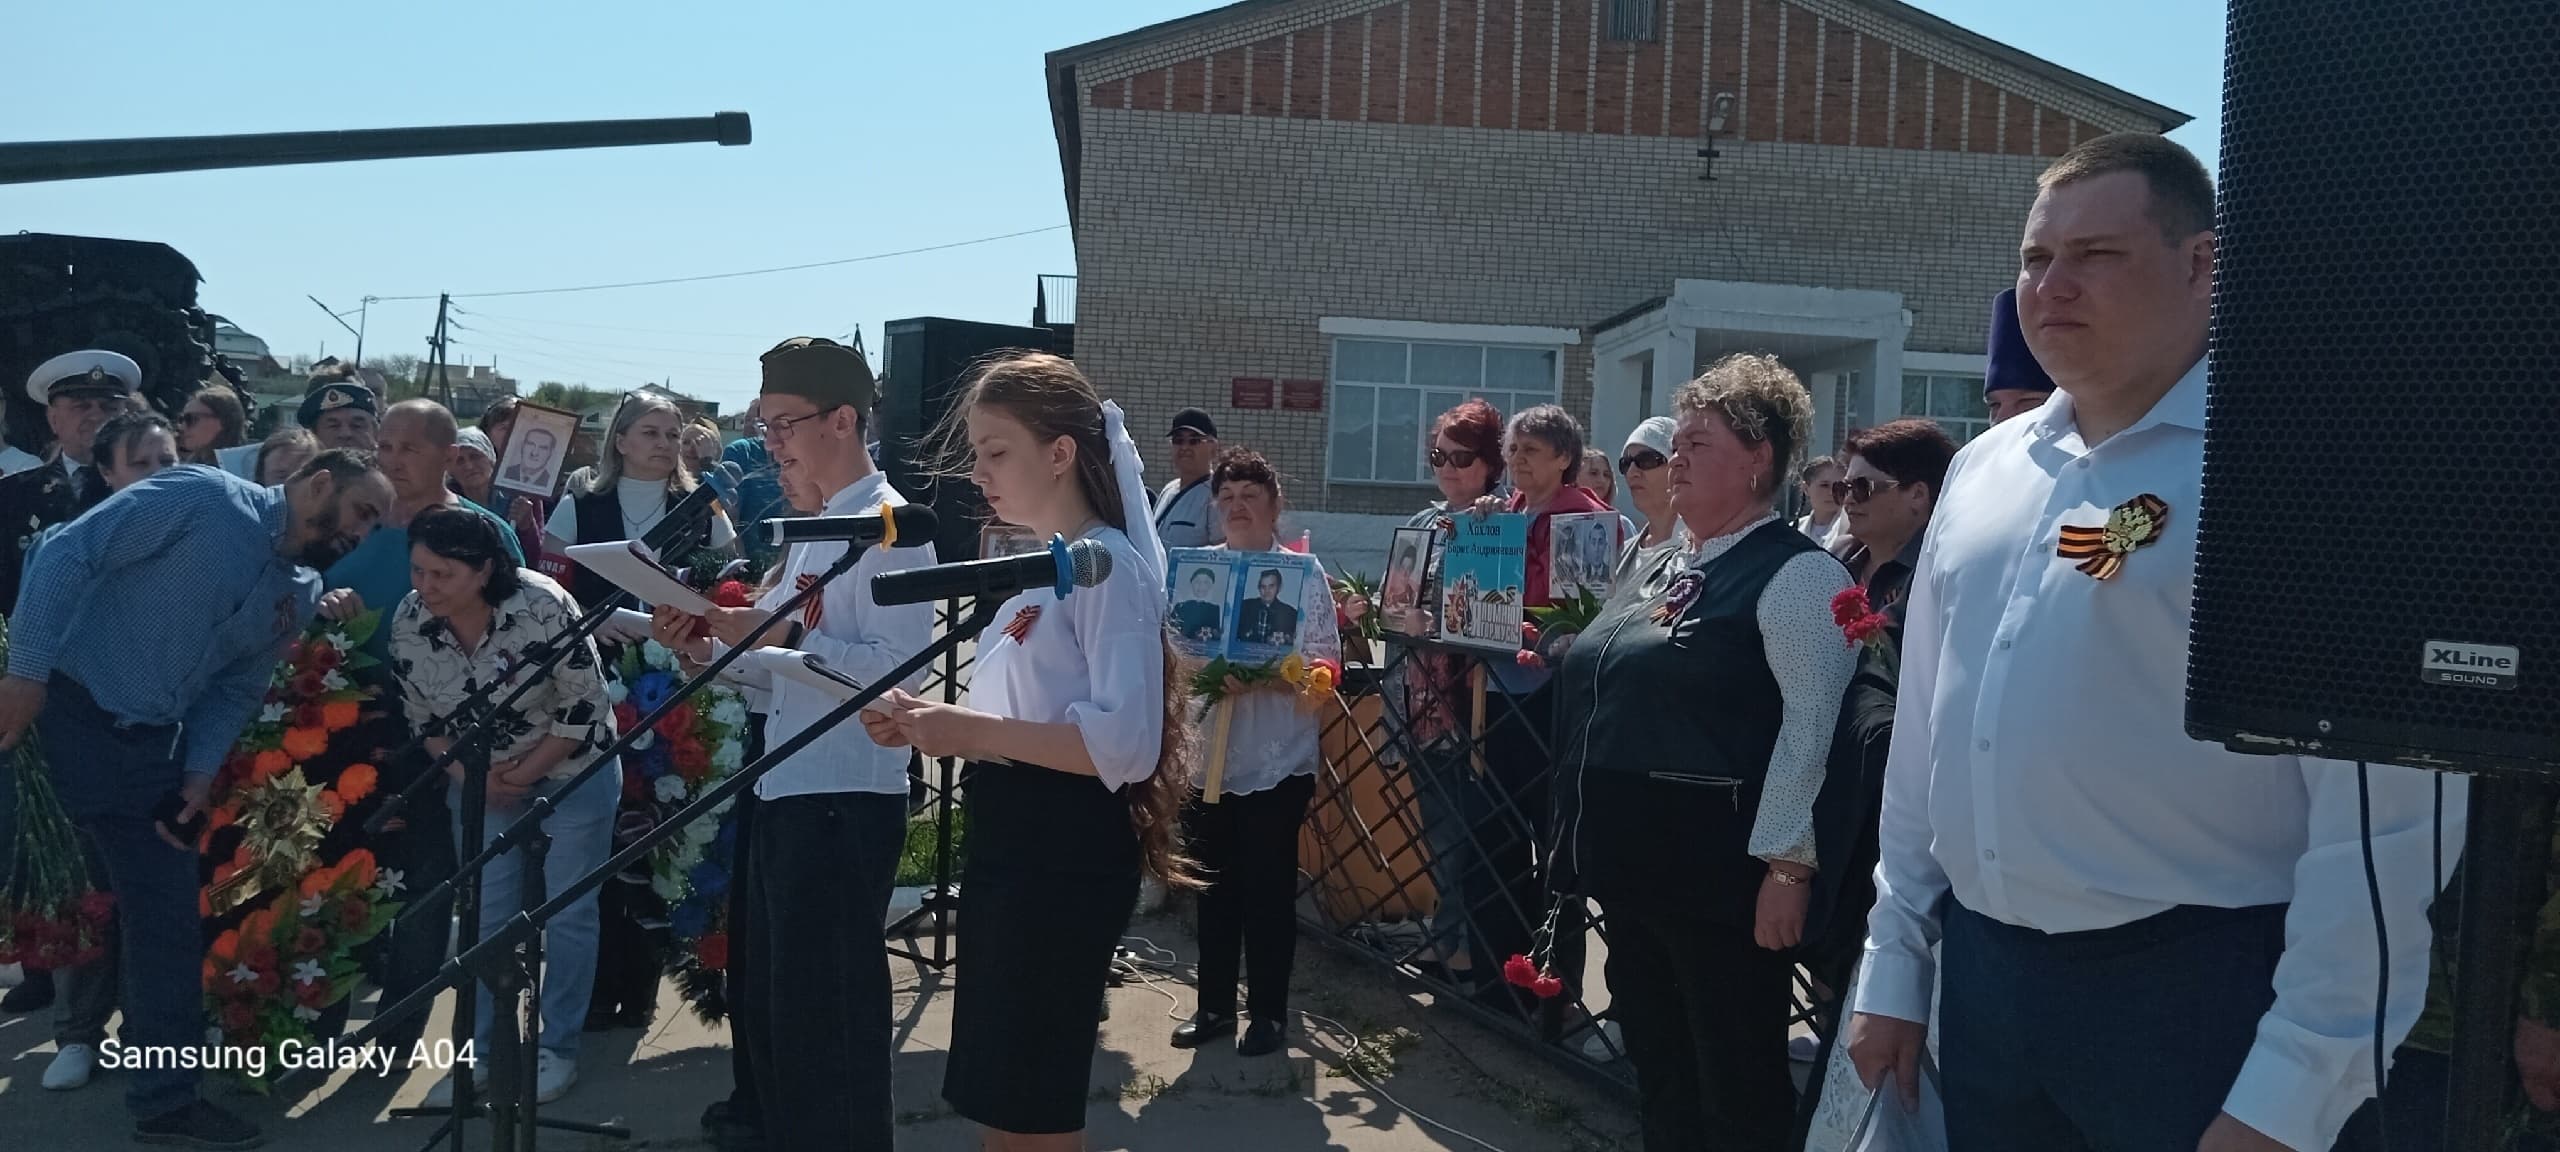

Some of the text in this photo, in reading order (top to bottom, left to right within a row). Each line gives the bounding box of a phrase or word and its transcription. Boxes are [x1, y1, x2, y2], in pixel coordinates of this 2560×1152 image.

[1467, 521, 1501, 536] Хохлов
[2430, 648, 2512, 669] XLine
[2441, 672, 2497, 686] SOUND
